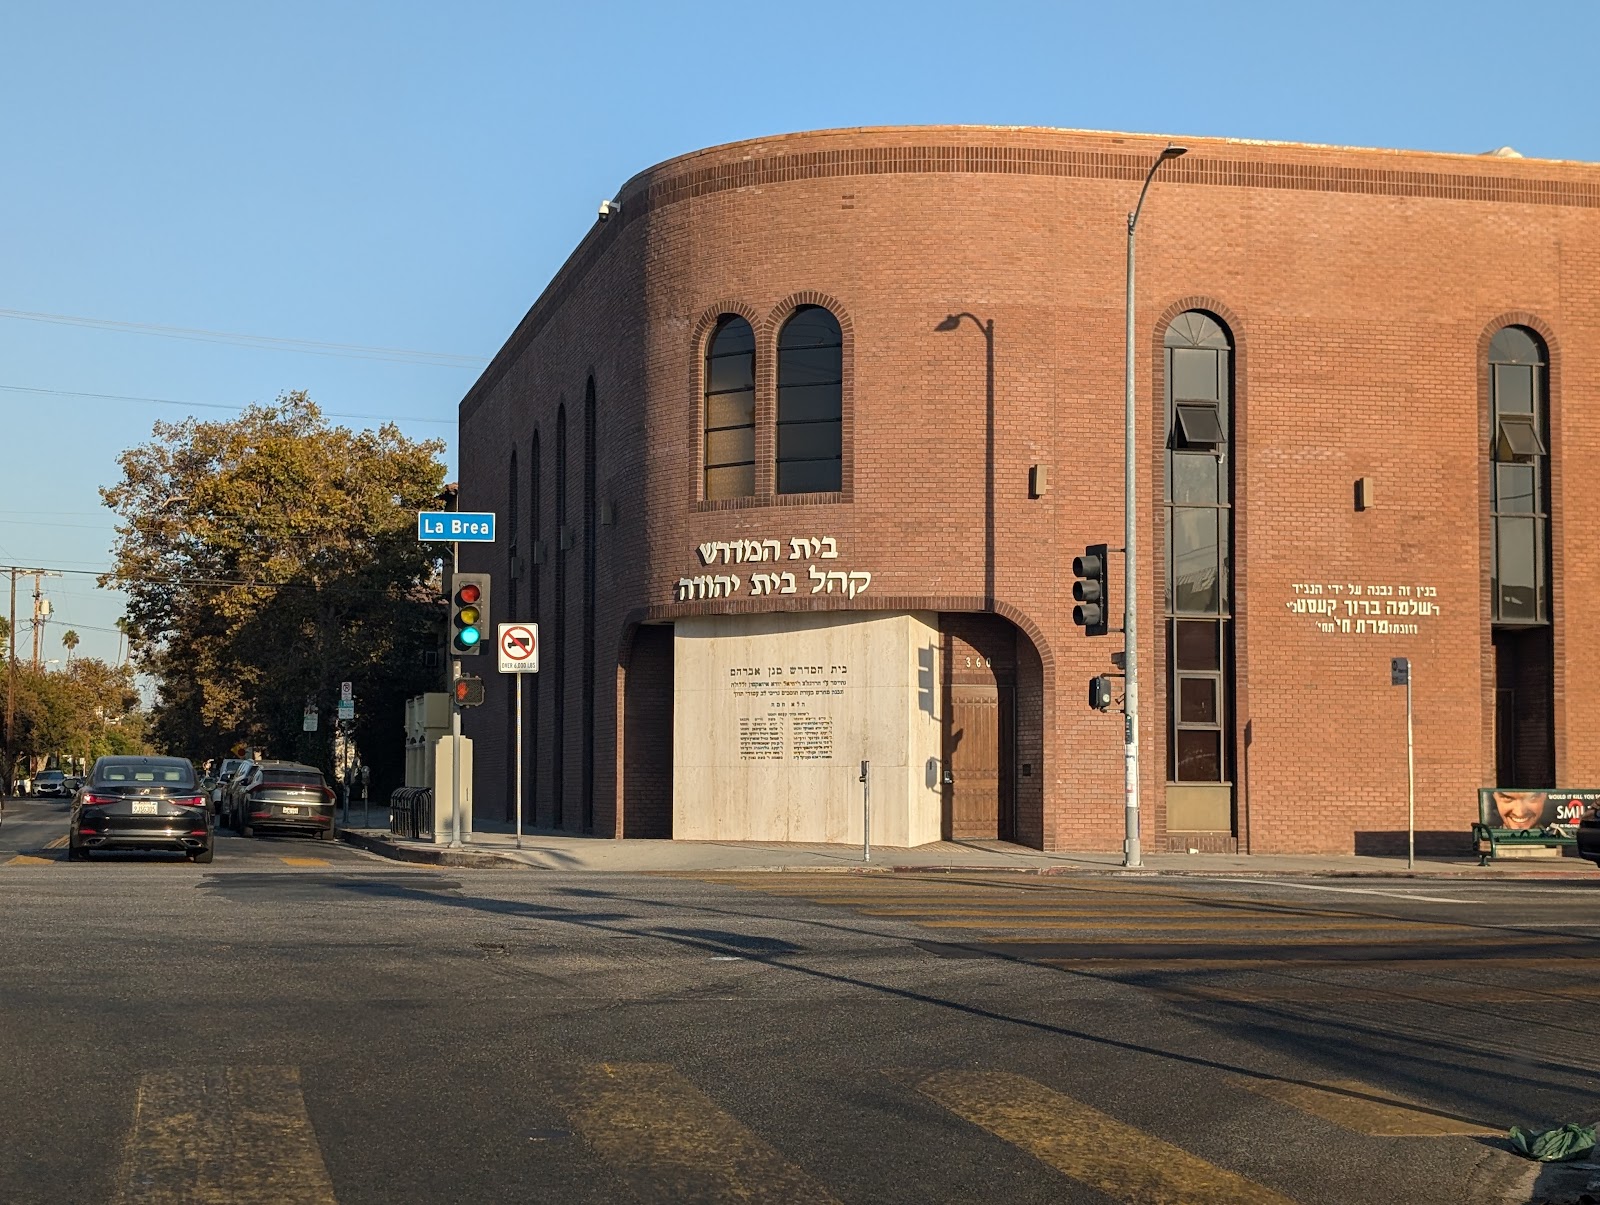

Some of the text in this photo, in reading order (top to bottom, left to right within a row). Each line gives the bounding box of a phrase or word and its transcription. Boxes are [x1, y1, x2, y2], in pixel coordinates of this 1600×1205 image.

[424, 519, 489, 535] La Brea
[699, 535, 838, 565] בית המדרש
[678, 564, 872, 601] קהל בית יהודה
[1292, 583, 1437, 598] בנין זה נבנה על ידי הנגיד
[1343, 600, 1381, 617] ברוך
[730, 667, 761, 677] אברהם
[789, 665, 824, 676] המדרש
[830, 665, 848, 675] בית
[1556, 805, 1588, 819] SMI
